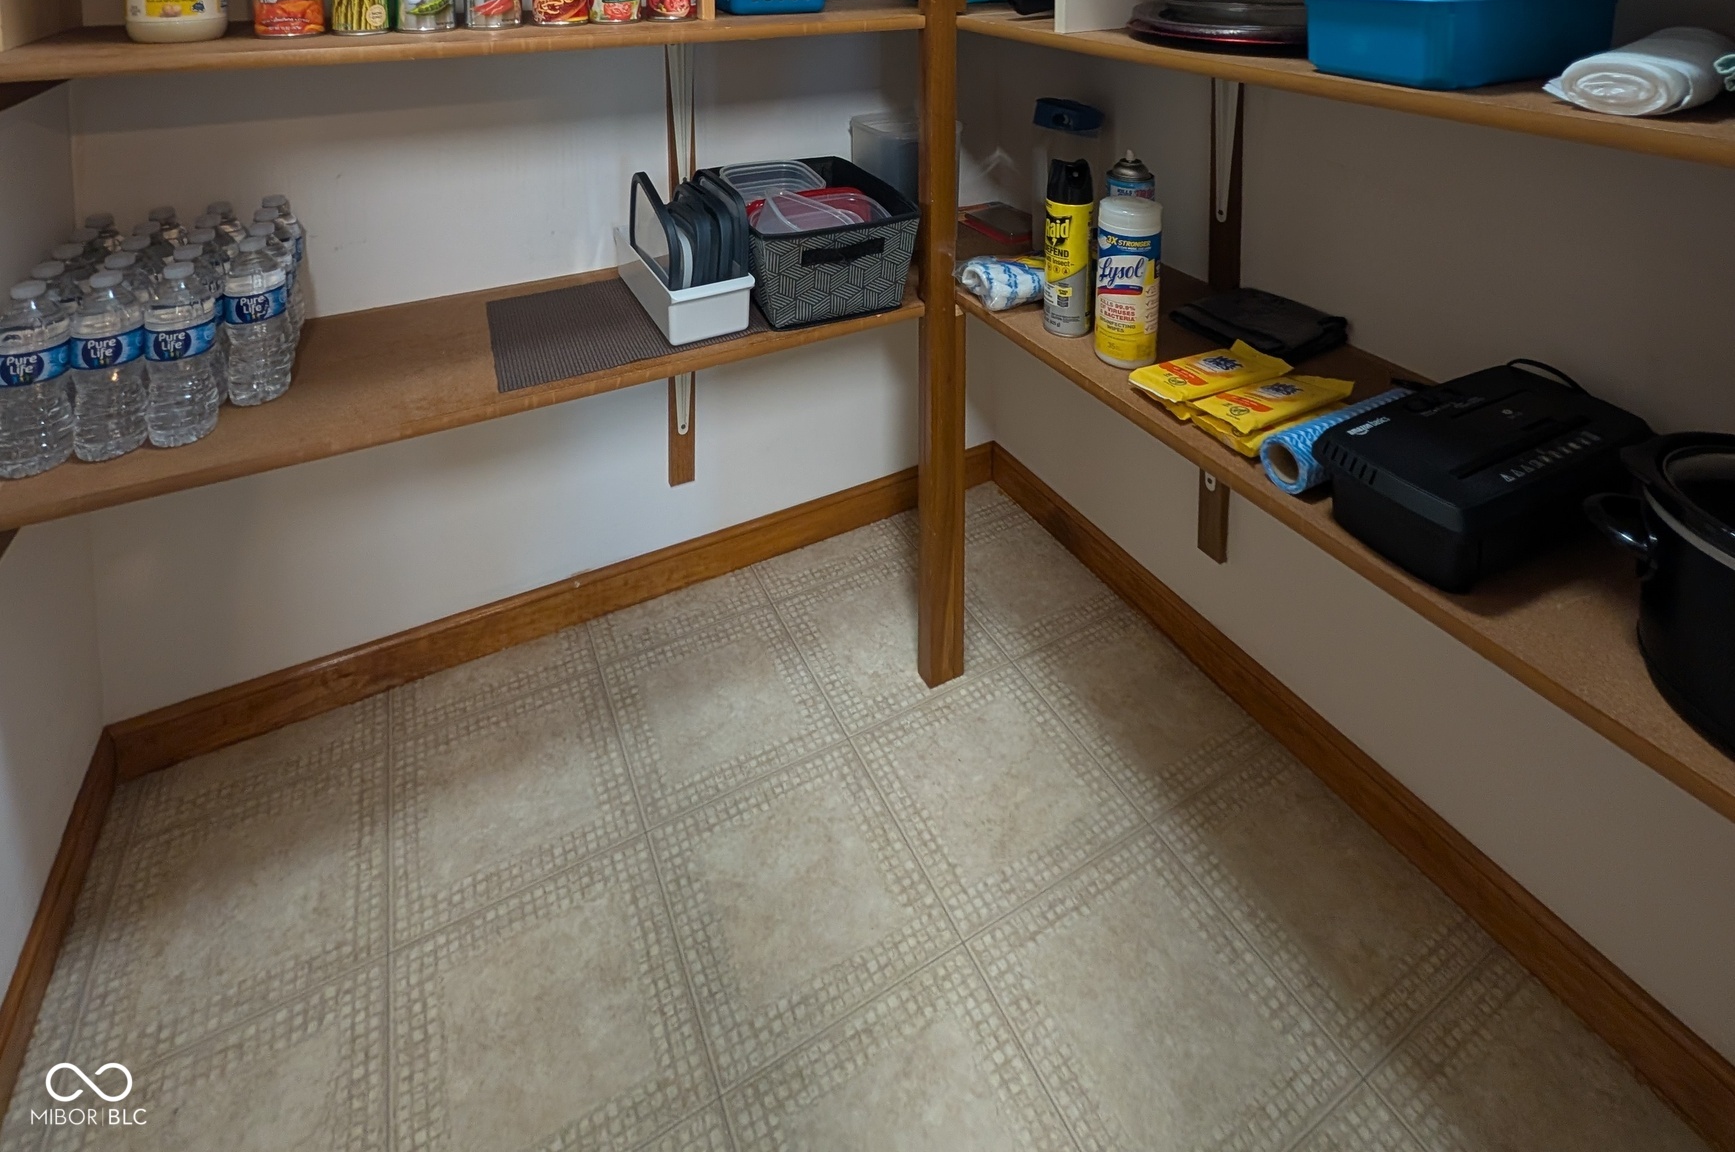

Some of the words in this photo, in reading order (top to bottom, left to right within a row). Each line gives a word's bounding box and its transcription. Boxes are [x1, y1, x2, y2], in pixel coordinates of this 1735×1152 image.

[1046, 219, 1070, 239] Raid
[1106, 235, 1119, 246] 3X
[1046, 246, 1070, 258] EFEND
[1052, 258, 1070, 267] Insect
[1099, 257, 1145, 286] Lysol
[239, 295, 265, 309] Pure
[243, 303, 263, 315] Life
[1107, 306, 1136, 317] VIRUSES
[1104, 311, 1136, 322] BACTERIA
[158, 330, 187, 344] Pure
[87, 337, 118, 351] Pure
[161, 339, 183, 352] Life
[6, 353, 38, 366] Pure
[90, 346, 114, 360] Life
[9, 362, 34, 377] Life
